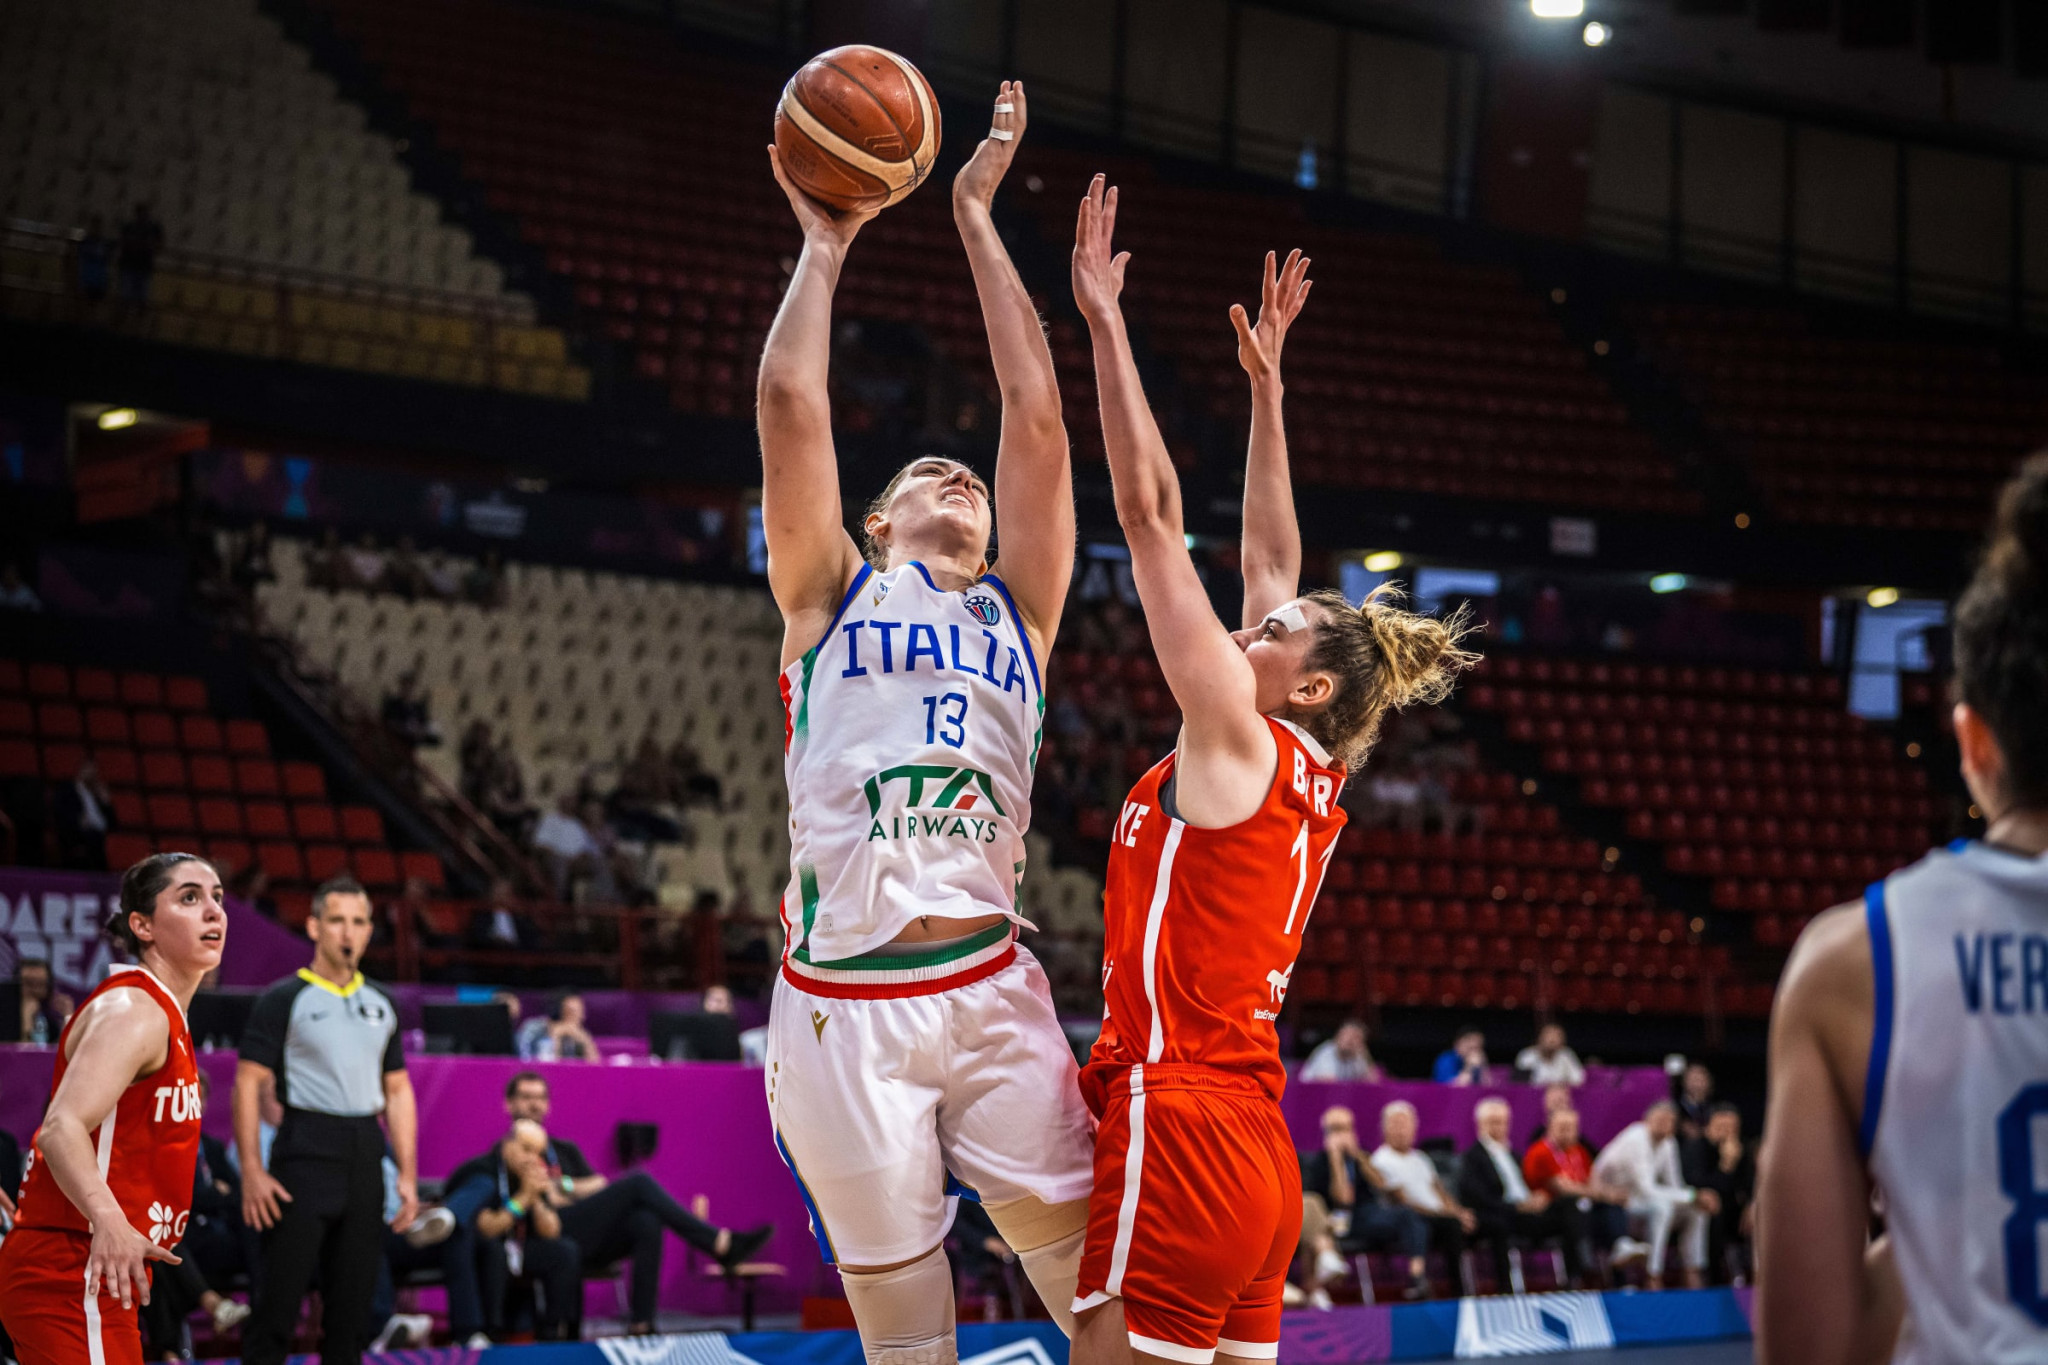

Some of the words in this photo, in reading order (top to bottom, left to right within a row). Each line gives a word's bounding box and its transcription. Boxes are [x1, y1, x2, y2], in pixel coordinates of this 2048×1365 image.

[842, 620, 1026, 704] ITALIA
[922, 692, 969, 749] 13
[863, 765, 1007, 820] ITA
[1293, 746, 1346, 818] BR
[868, 815, 998, 844] AIRWAYS
[1112, 800, 1151, 848] YE
[1953, 930, 2048, 1016] VER
